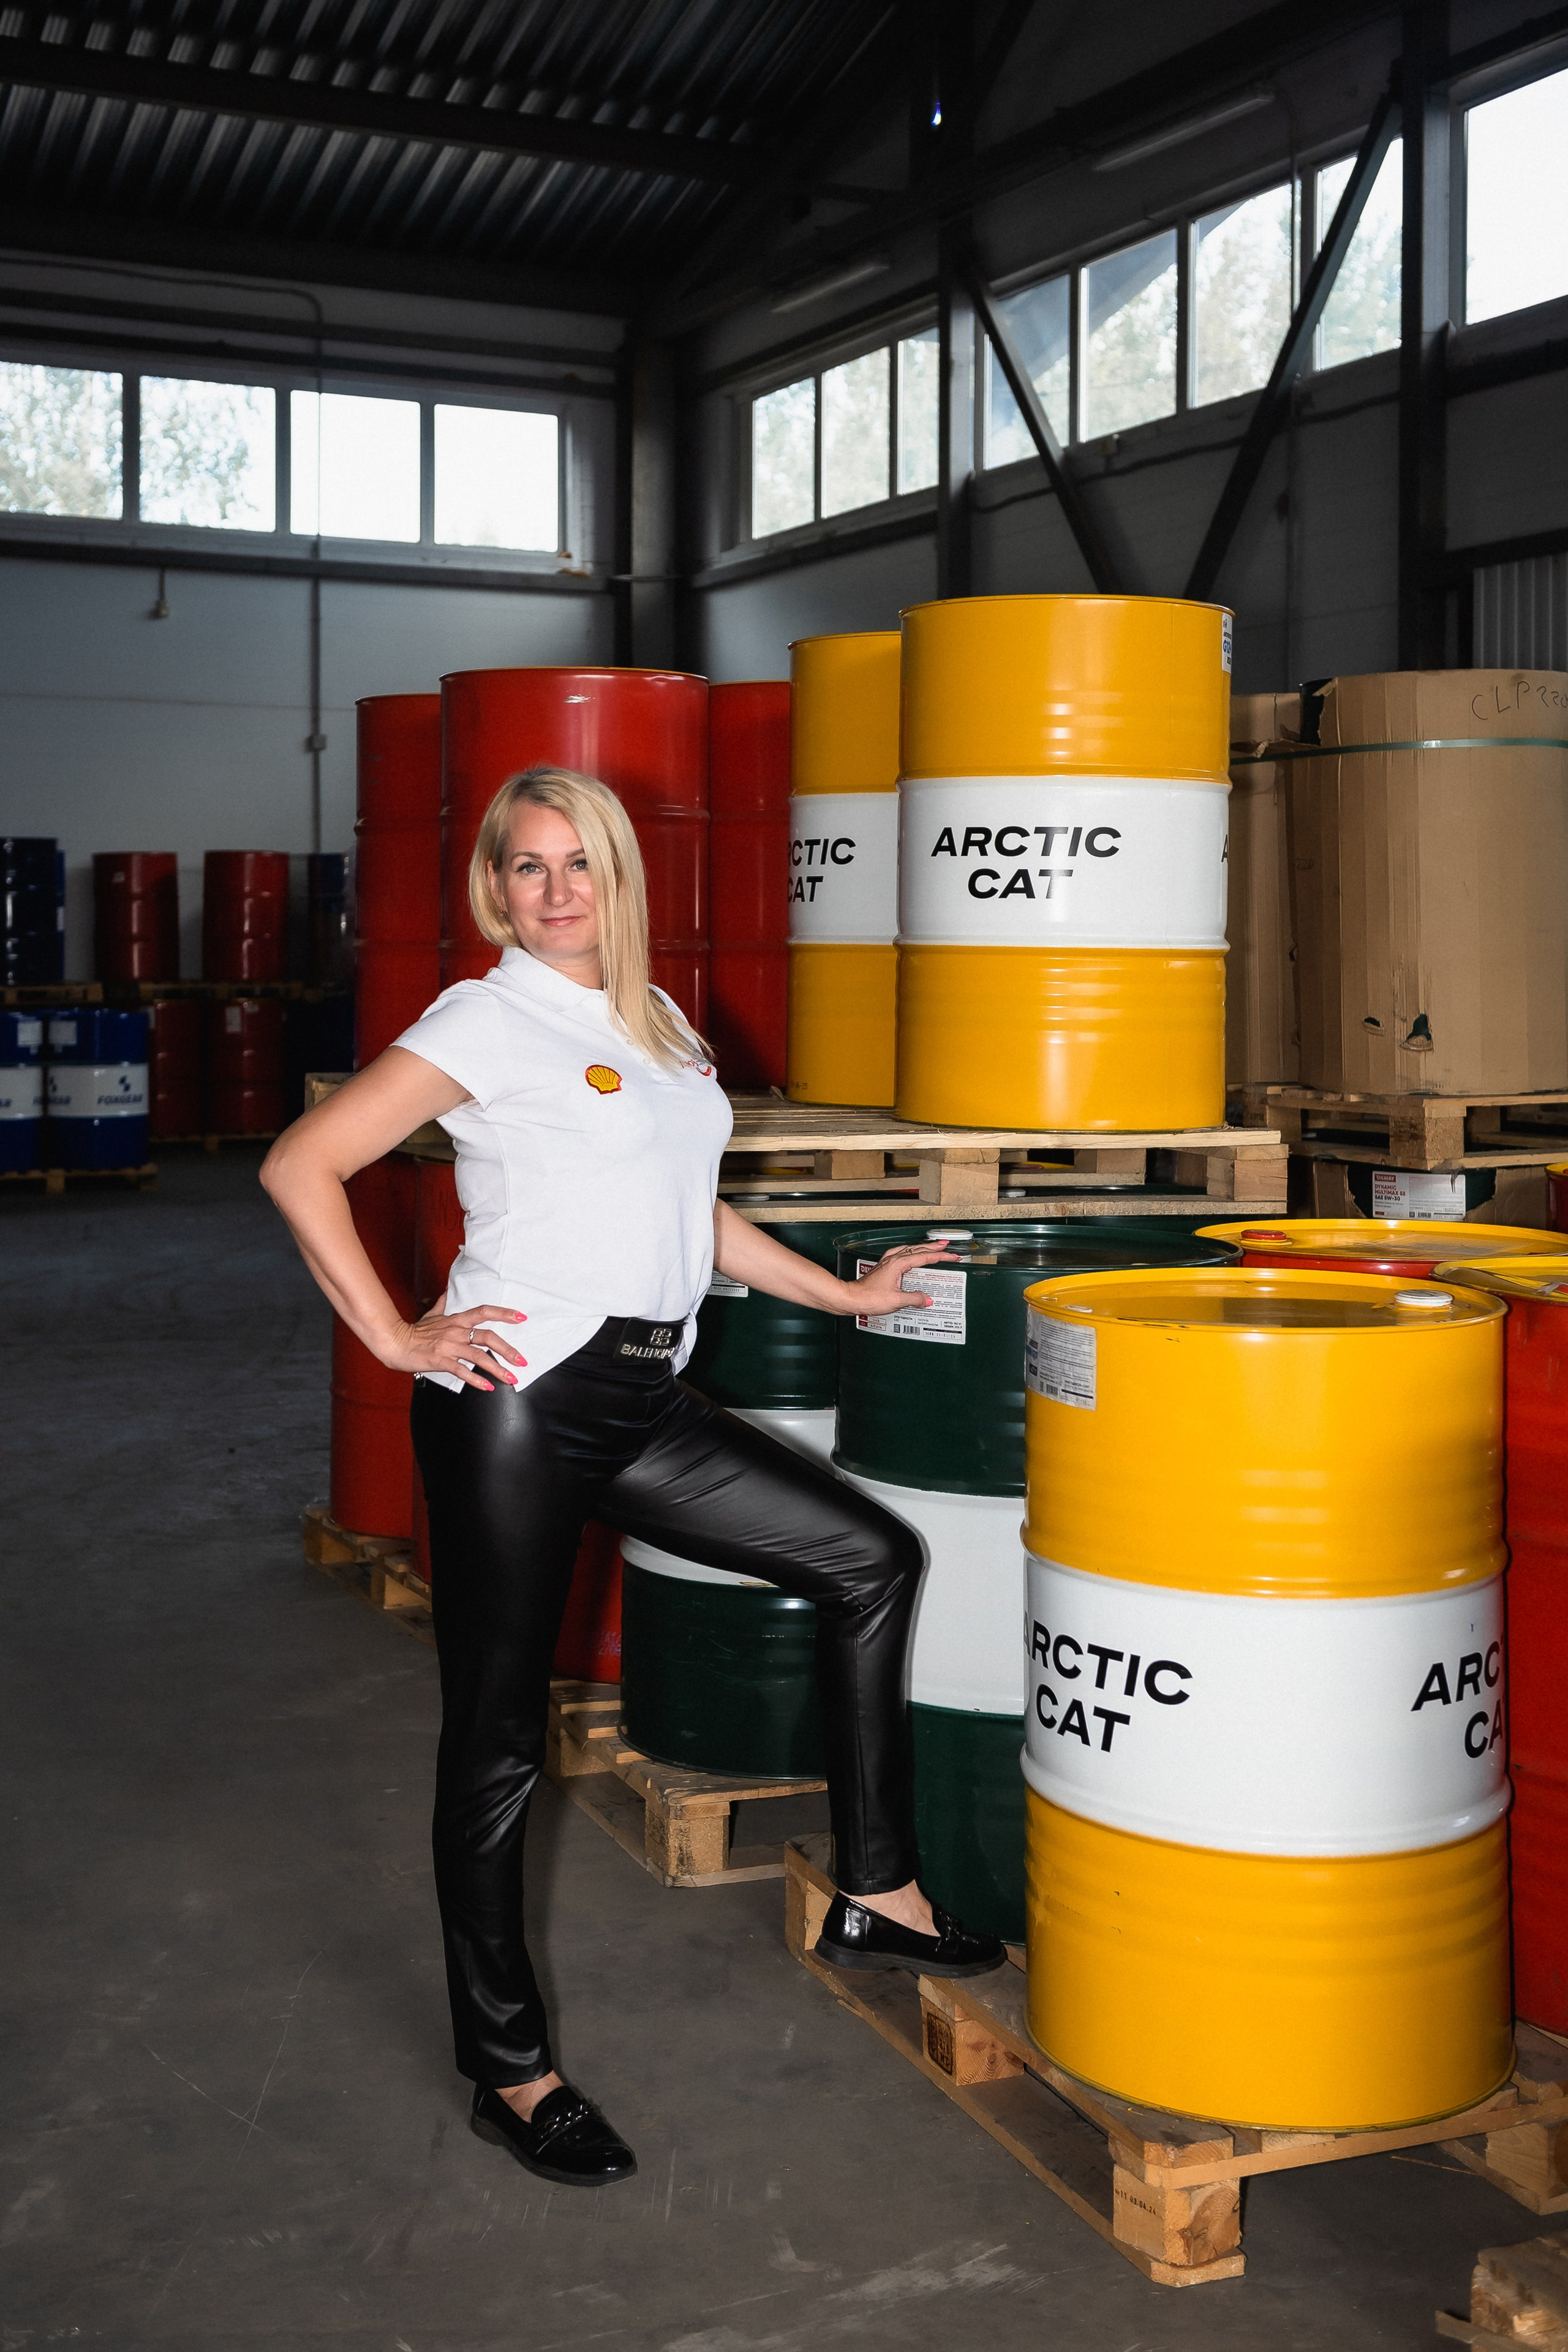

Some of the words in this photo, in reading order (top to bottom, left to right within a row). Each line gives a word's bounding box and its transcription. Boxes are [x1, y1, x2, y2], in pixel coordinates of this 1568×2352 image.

[1471, 680, 1530, 720] CLP
[930, 825, 1122, 858] ARCTIC
[967, 868, 1074, 899] CAT
[1024, 1610, 1193, 1705] ARCTIC
[1036, 1683, 1131, 1754] CAT
